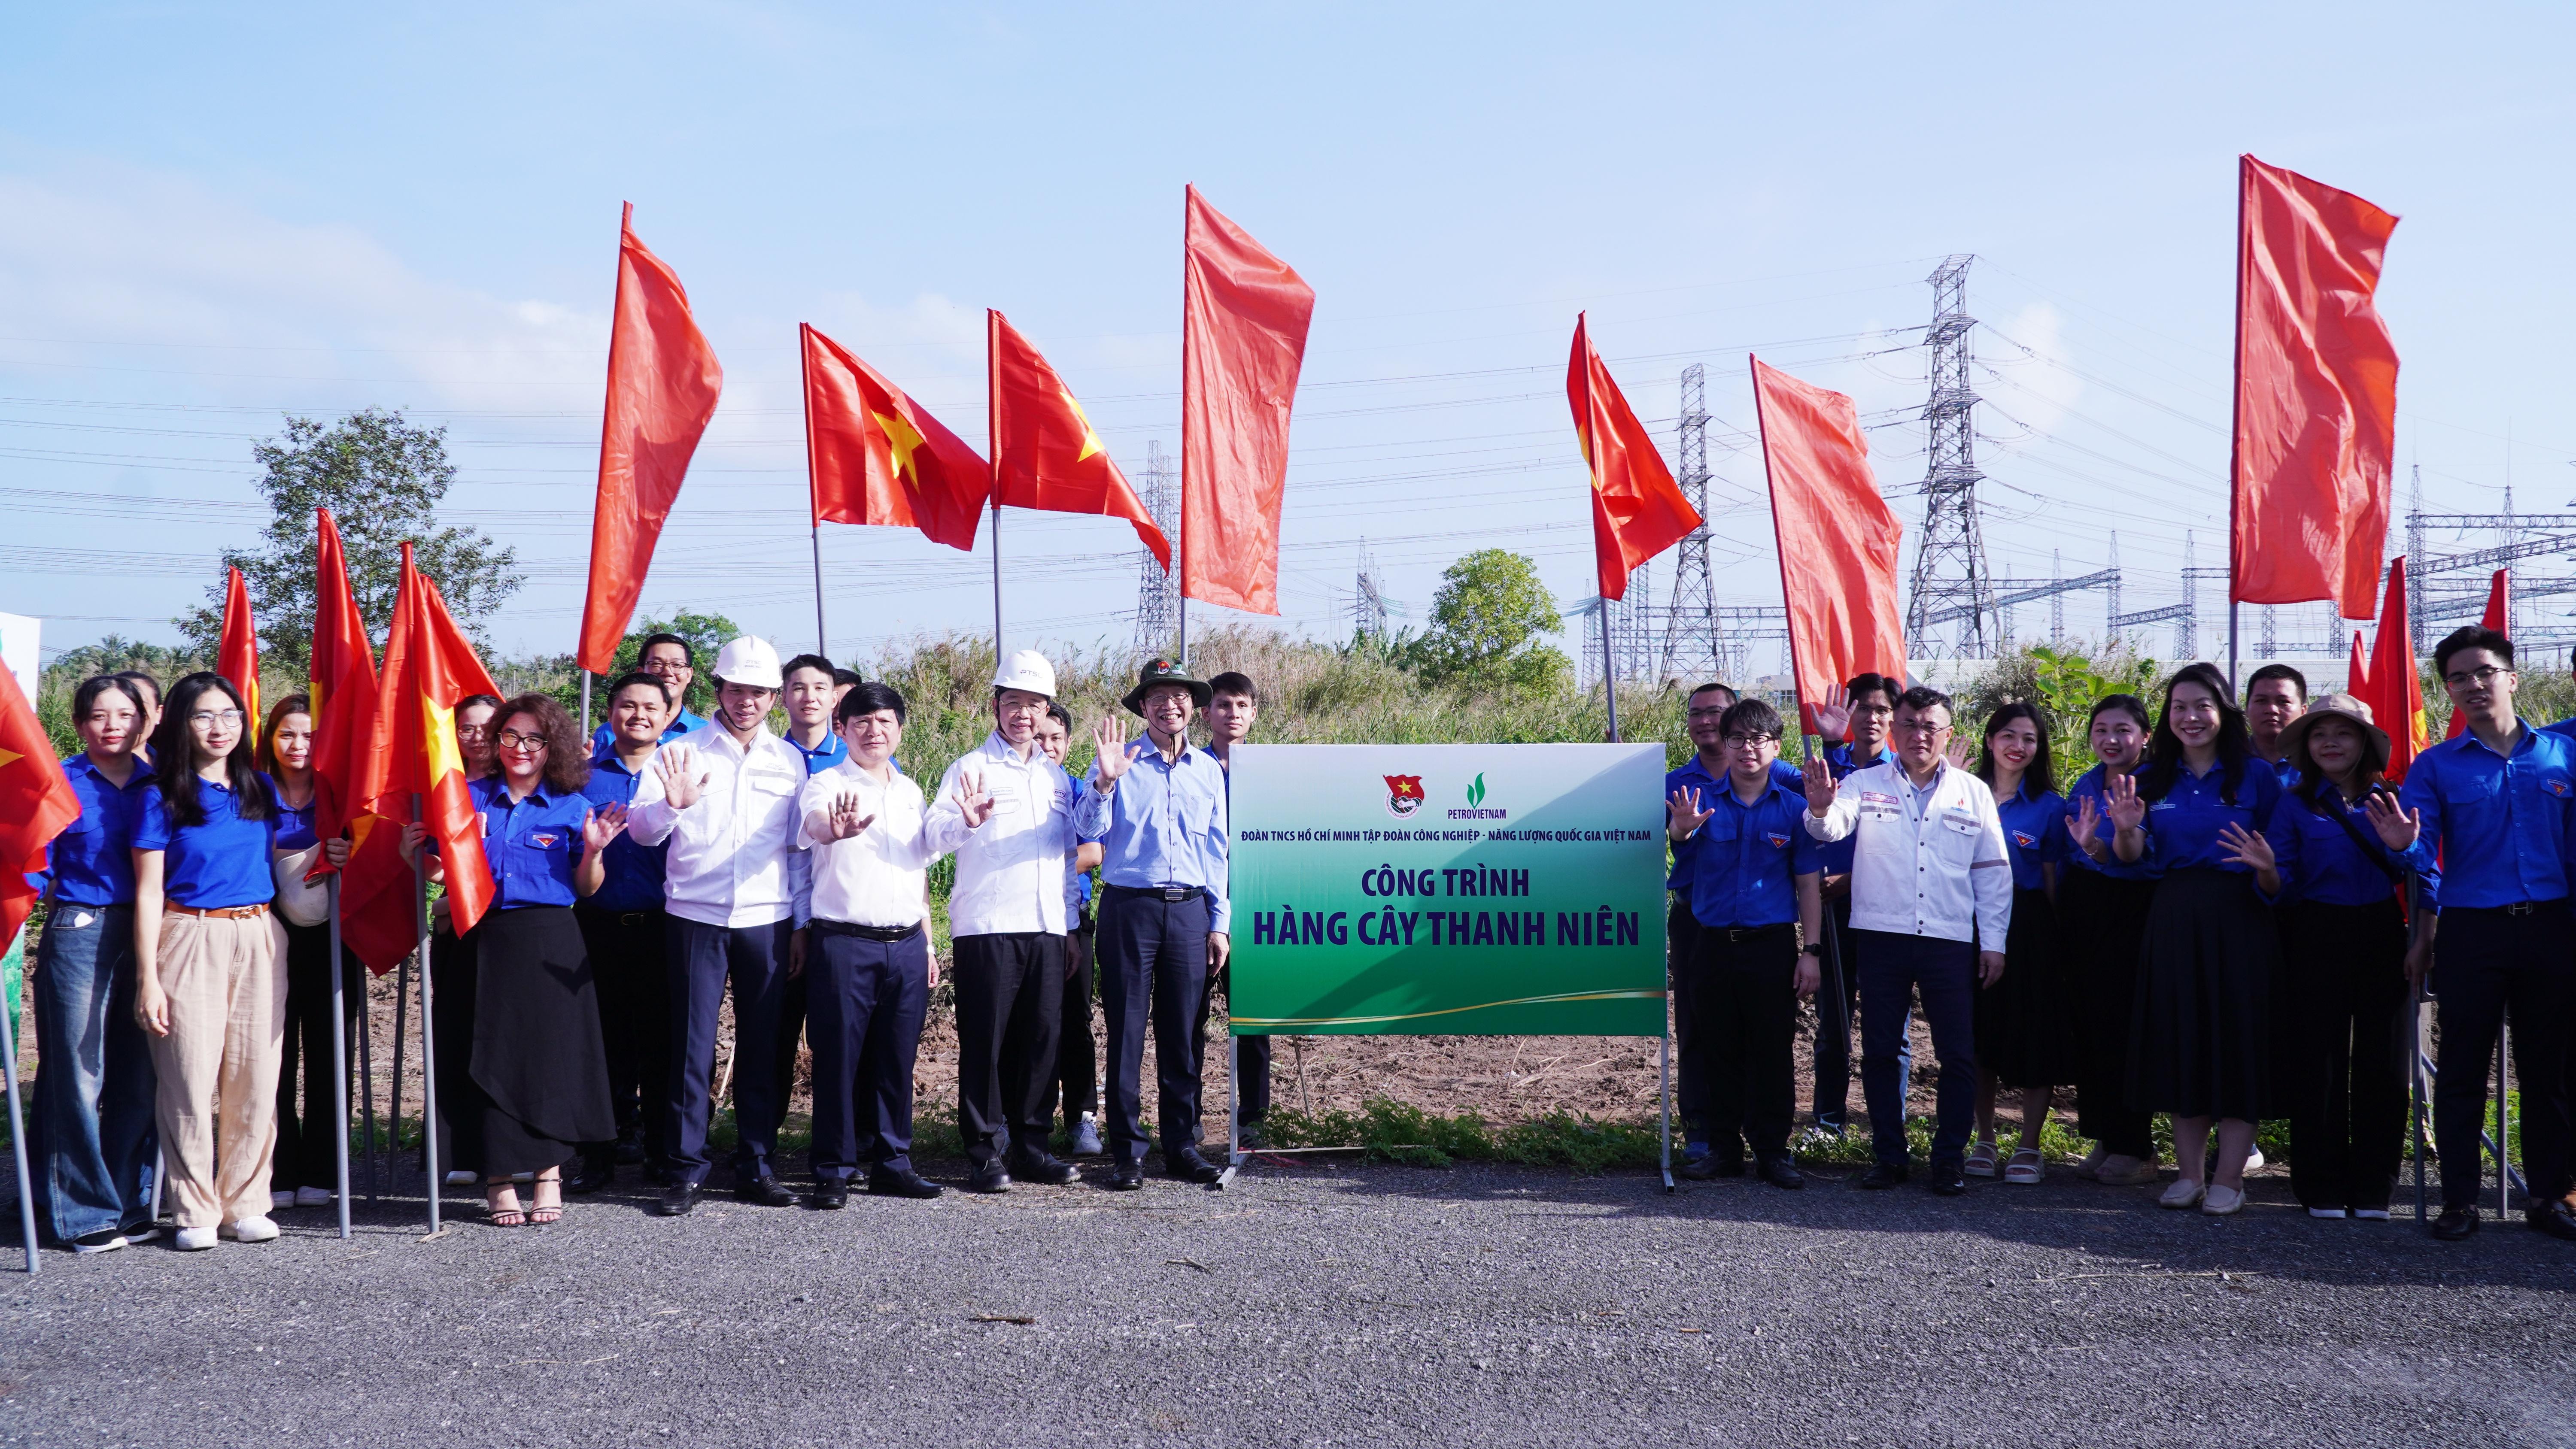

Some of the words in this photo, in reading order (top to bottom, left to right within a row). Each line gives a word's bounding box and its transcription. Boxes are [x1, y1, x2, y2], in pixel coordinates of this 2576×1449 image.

[1448, 809, 1507, 819] PETROVIETNAM
[1241, 829, 1268, 841] ĐOÀN
[1271, 831, 1295, 841] TNCS
[1298, 828, 1311, 841] HỒ
[1314, 829, 1331, 841] CHÍ
[1333, 831, 1360, 841] MINH
[1363, 829, 1381, 843] TẬP
[1383, 829, 1410, 841] ĐOÀN
[1413, 829, 1439, 841] CÔNG
[1443, 829, 1479, 843] NGHIỆP
[1488, 829, 1516, 841] NĂNG
[1519, 830, 1552, 843] LƯỢNG
[1555, 828, 1582, 842] QUỐC
[1584, 831, 1601, 841] GIA
[1603, 829, 1625, 843] VIỆT
[1628, 831, 1651, 840] NAM
[1362, 863, 1435, 896] CÔNG
[1443, 863, 1529, 896] TRÌNH
[1254, 904, 1348, 946] HÀNG
[1358, 905, 1419, 946] CÂY
[1427, 912, 1545, 946] THANH
[1558, 905, 1639, 946] NIÊN
